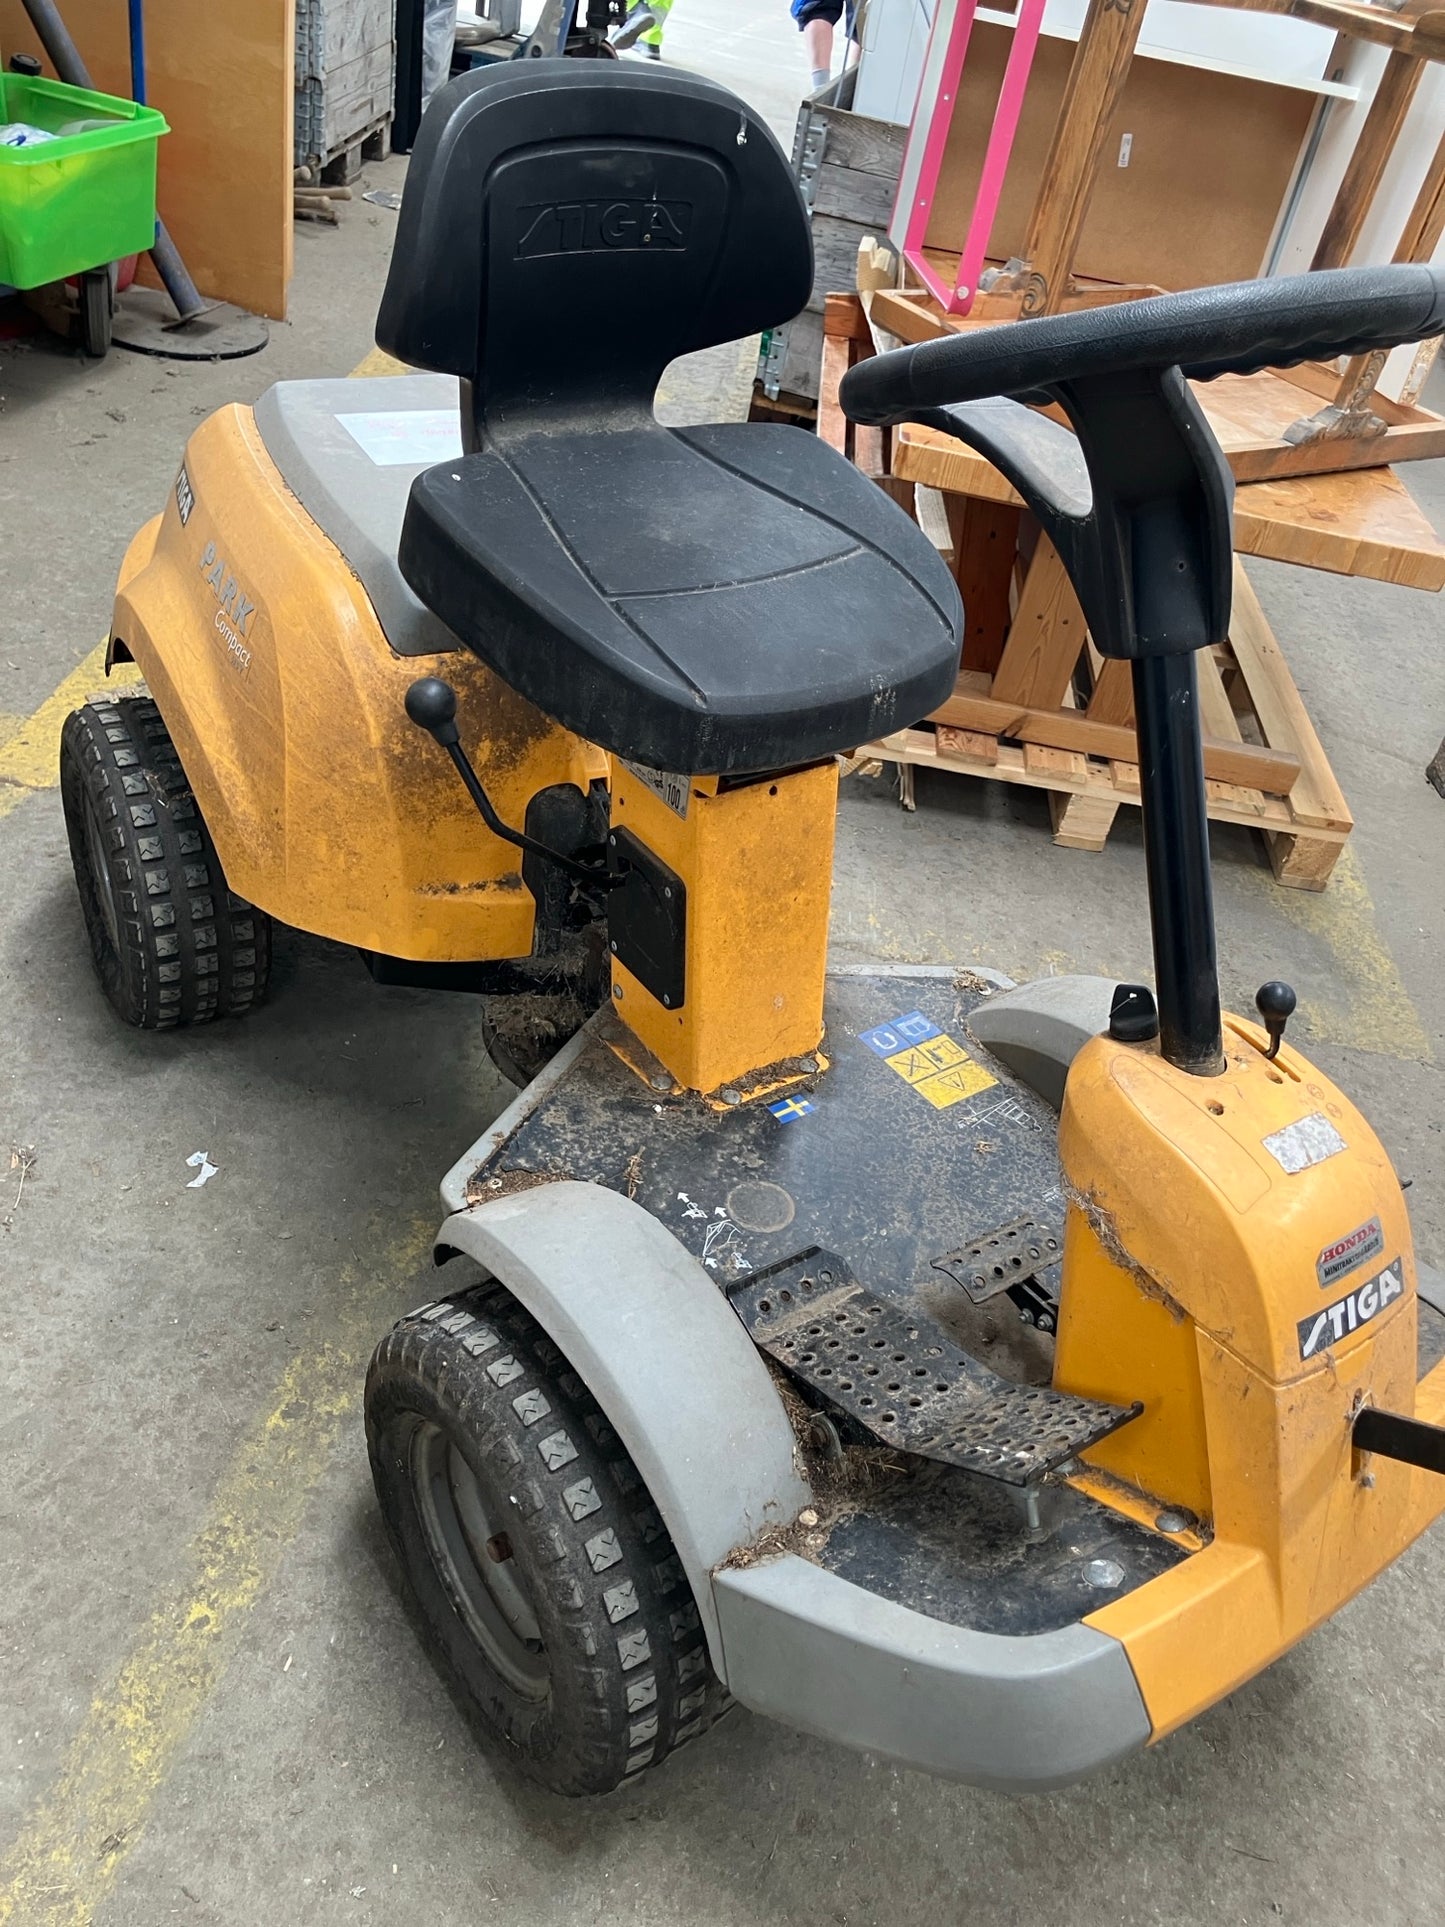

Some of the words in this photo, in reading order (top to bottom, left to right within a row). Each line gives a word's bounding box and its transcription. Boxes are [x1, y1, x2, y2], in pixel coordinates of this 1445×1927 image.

[517, 203, 683, 254] STIGA
[200, 540, 254, 637] PARK
[214, 609, 251, 668] Compact
[667, 783, 680, 809] 100
[1322, 1223, 1377, 1263] HONDA
[1302, 1269, 1401, 1357] STIGA
